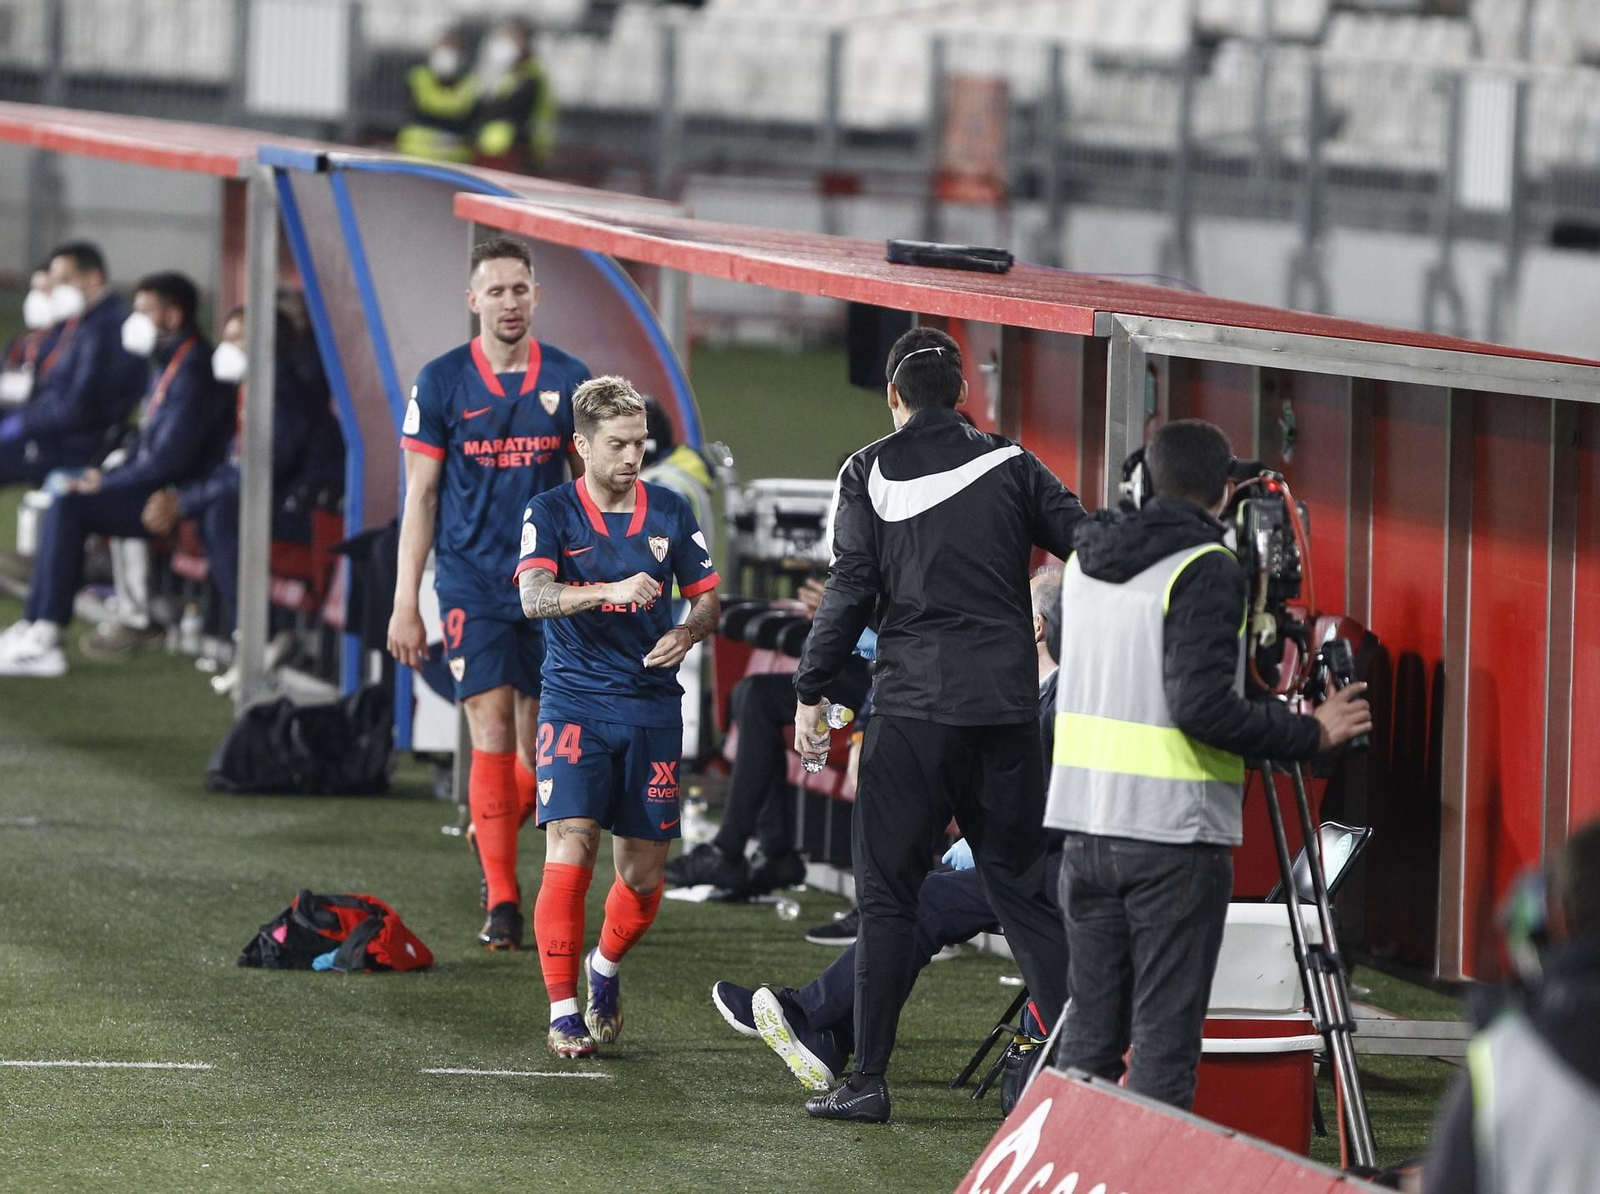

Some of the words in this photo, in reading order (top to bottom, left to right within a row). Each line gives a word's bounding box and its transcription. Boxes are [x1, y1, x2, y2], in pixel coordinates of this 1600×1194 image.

[463, 436, 561, 455] MARATHON
[498, 452, 534, 467] BET
[447, 607, 466, 649] 9
[537, 722, 582, 767] 24
[550, 939, 576, 952] SFC
